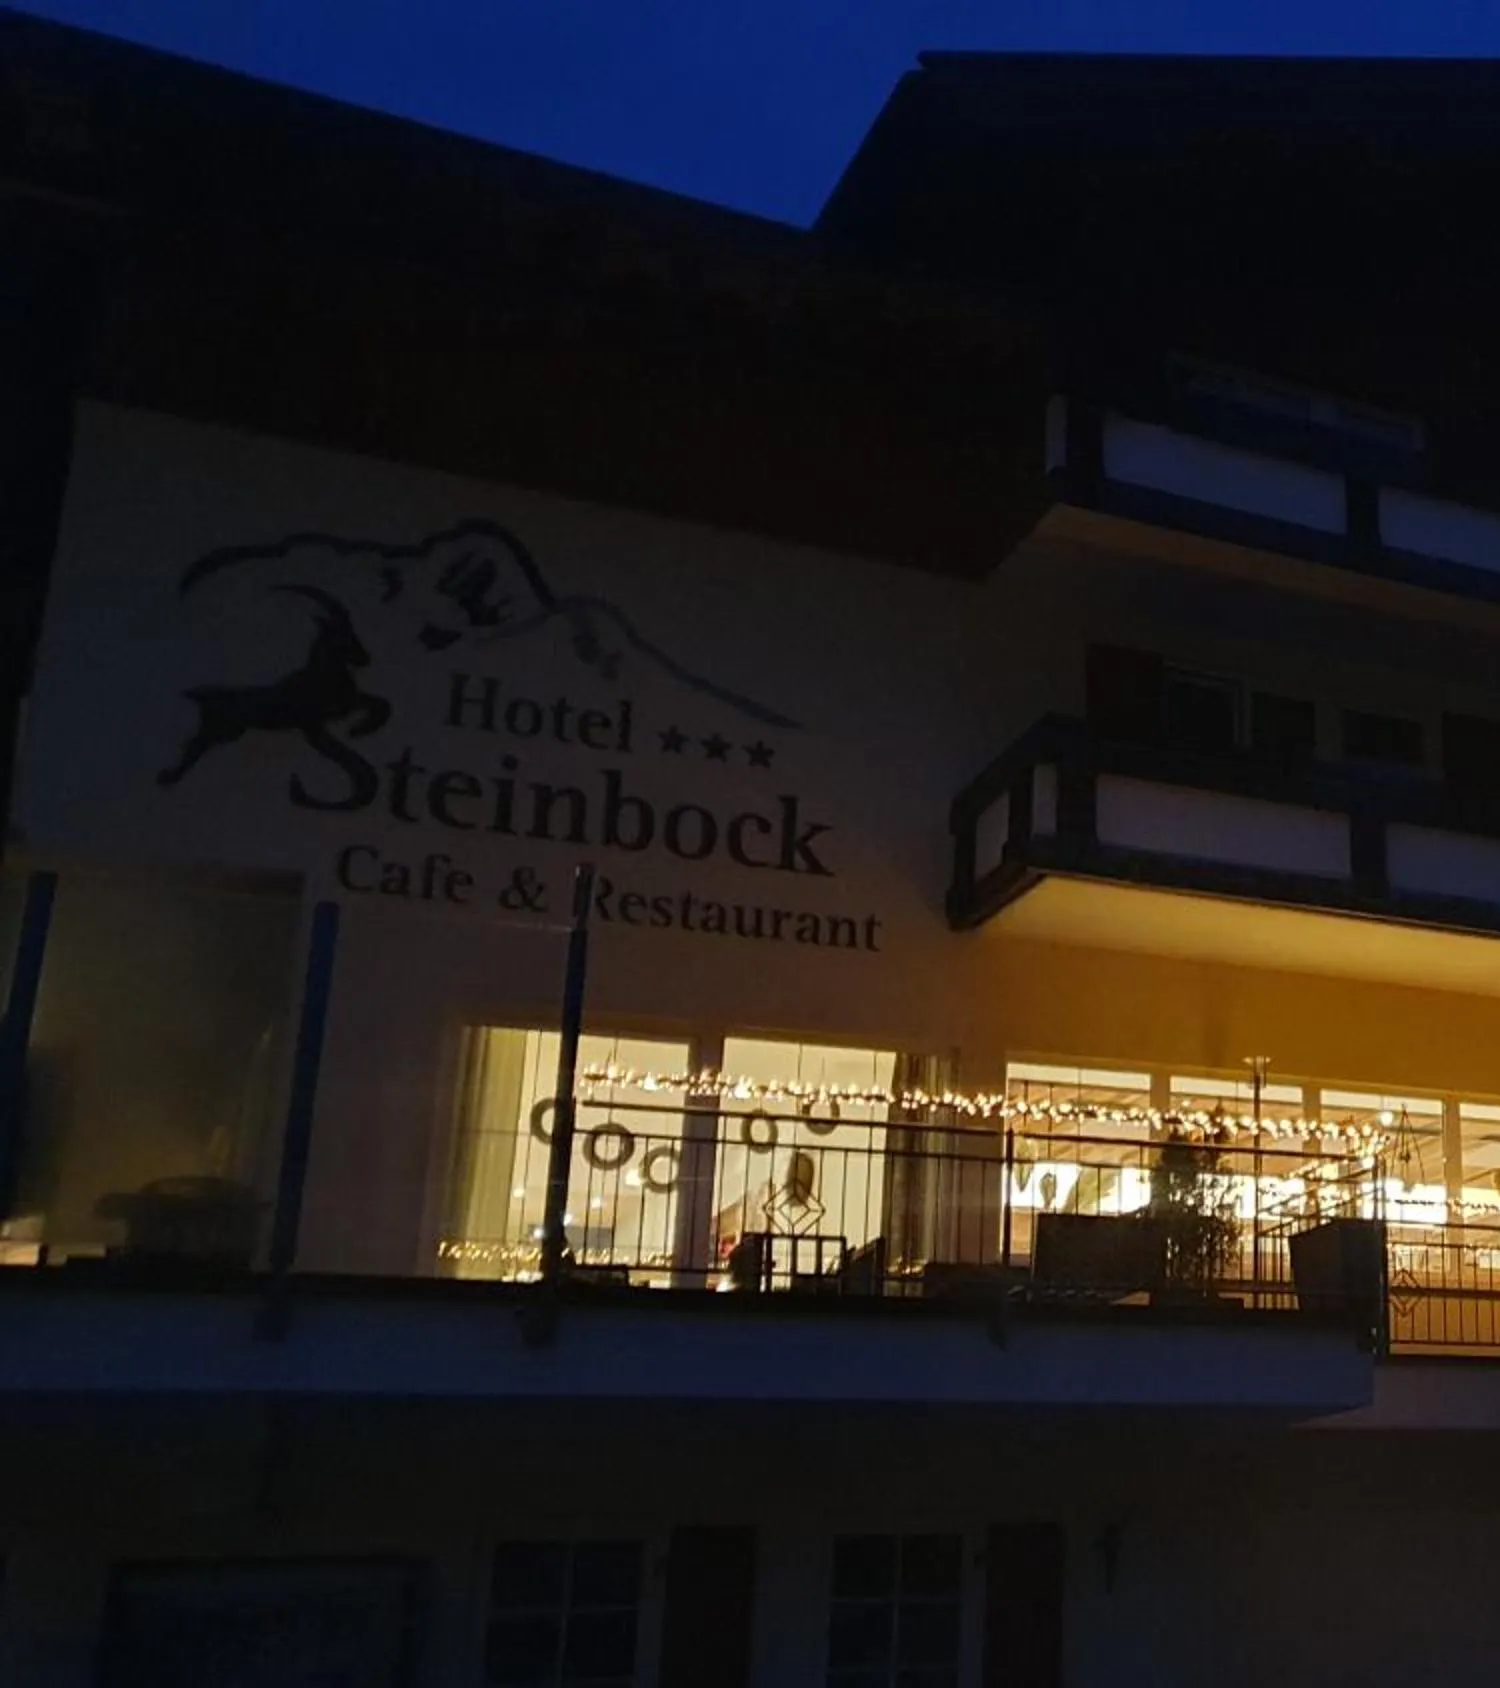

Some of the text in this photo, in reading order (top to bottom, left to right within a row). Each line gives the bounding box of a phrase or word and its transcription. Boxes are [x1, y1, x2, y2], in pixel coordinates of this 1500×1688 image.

[446, 673, 634, 754] Hotel
[288, 732, 836, 878] Steinbock
[337, 844, 476, 904] Cafe
[497, 865, 551, 914] &
